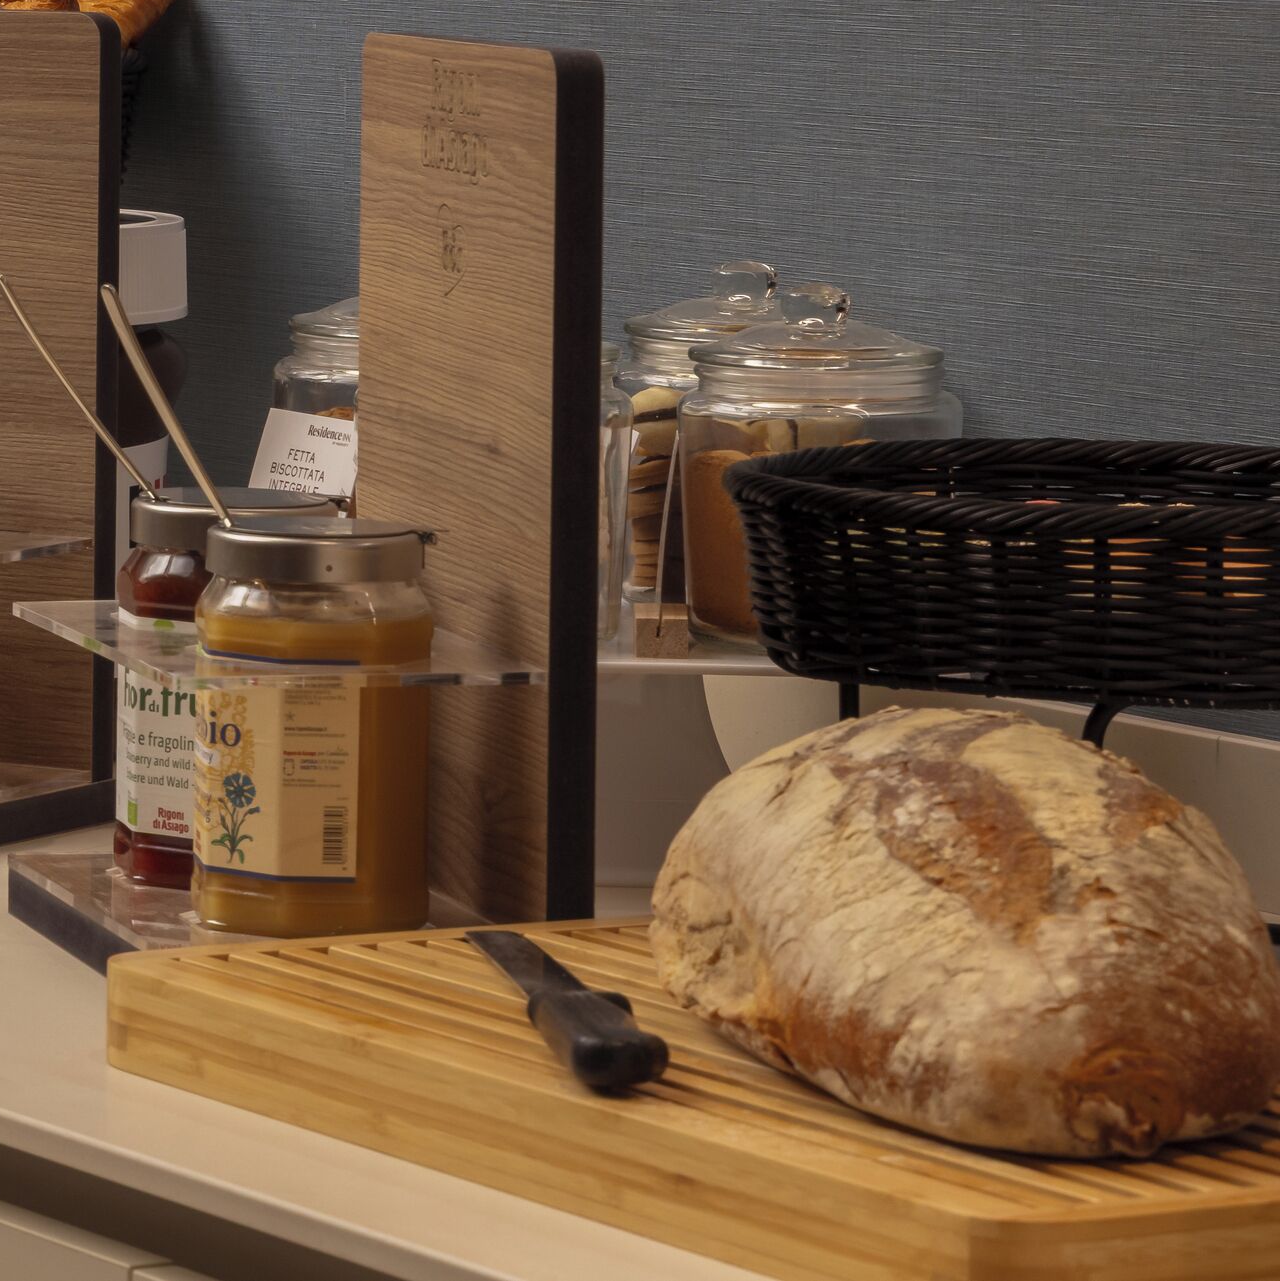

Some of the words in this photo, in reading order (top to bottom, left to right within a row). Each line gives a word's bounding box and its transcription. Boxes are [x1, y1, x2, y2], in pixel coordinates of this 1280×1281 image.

[307, 424, 343, 441] Residence
[287, 448, 316, 464] FETTA
[270, 461, 325, 482] BISCOTTATA
[148, 700, 159, 712] di
[160, 686, 197, 718] fru
[138, 733, 145, 746] e
[148, 731, 195, 753] fragolin
[153, 756, 170, 768] and
[172, 758, 191, 771] wild
[147, 774, 165, 787] und
[166, 775, 189, 789] Wald
[157, 807, 185, 821] Rigoni
